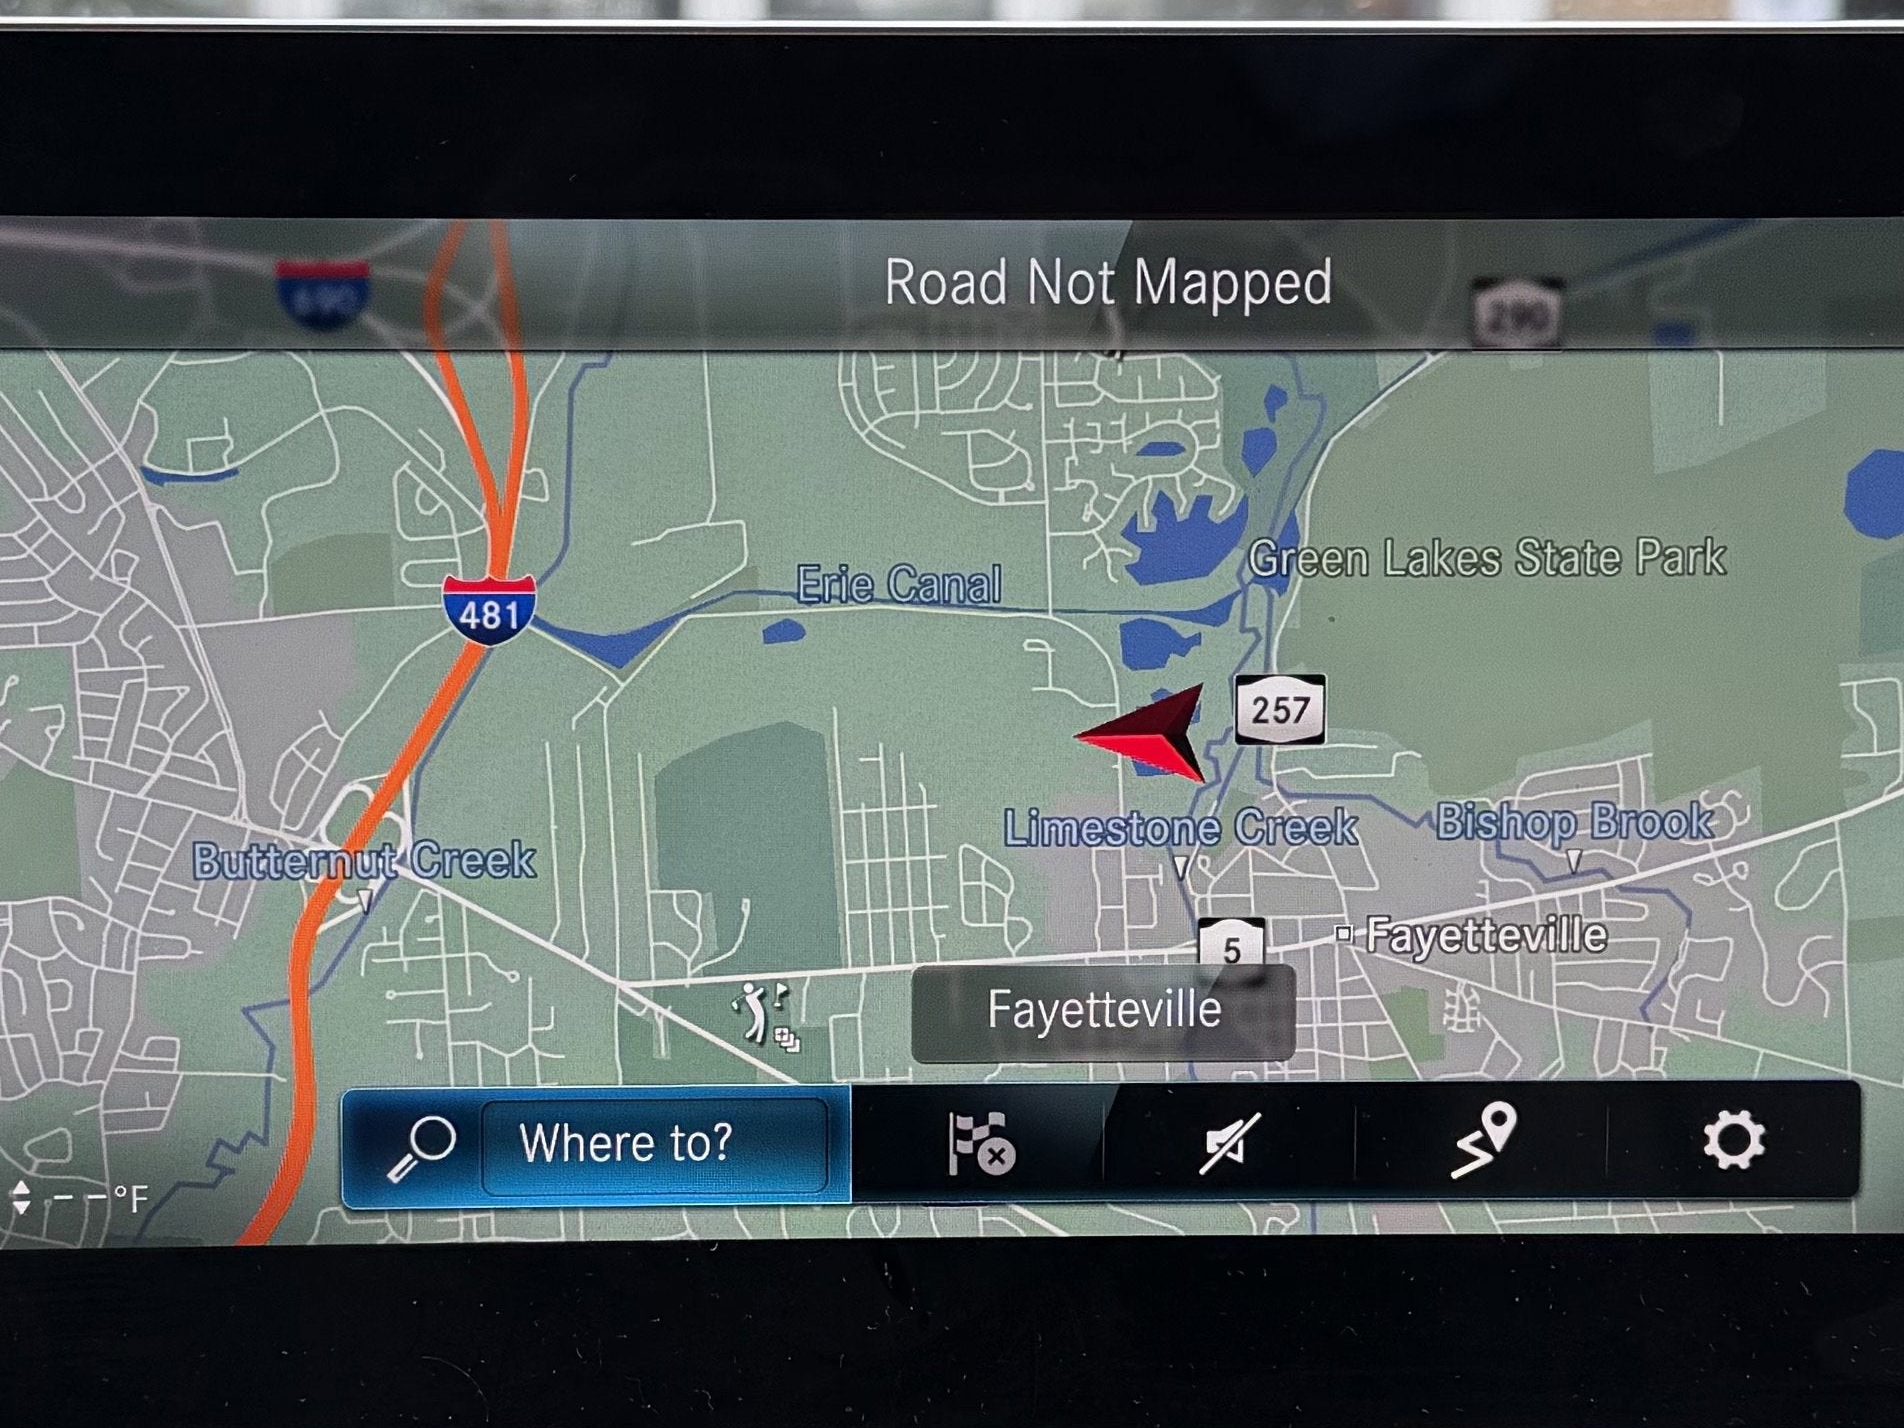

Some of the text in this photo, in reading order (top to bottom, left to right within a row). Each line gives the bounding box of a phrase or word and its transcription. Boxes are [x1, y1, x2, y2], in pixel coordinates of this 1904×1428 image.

[886, 255, 1333, 315] Road Not Mapped
[1249, 536, 1727, 578] Green Lakes State Park
[796, 564, 1002, 606] Erie Canal
[459, 602, 519, 630] 481
[1251, 697, 1312, 726] 257
[1004, 807, 1358, 848] Limestone Creek
[1436, 800, 1714, 851] Bishop Brook
[192, 839, 537, 881] Butternut Creek
[1224, 938, 1241, 966] 5
[1366, 915, 1609, 959] Fayetteville
[988, 987, 1222, 1039] Fayetteville
[519, 1122, 734, 1163] Where to?
